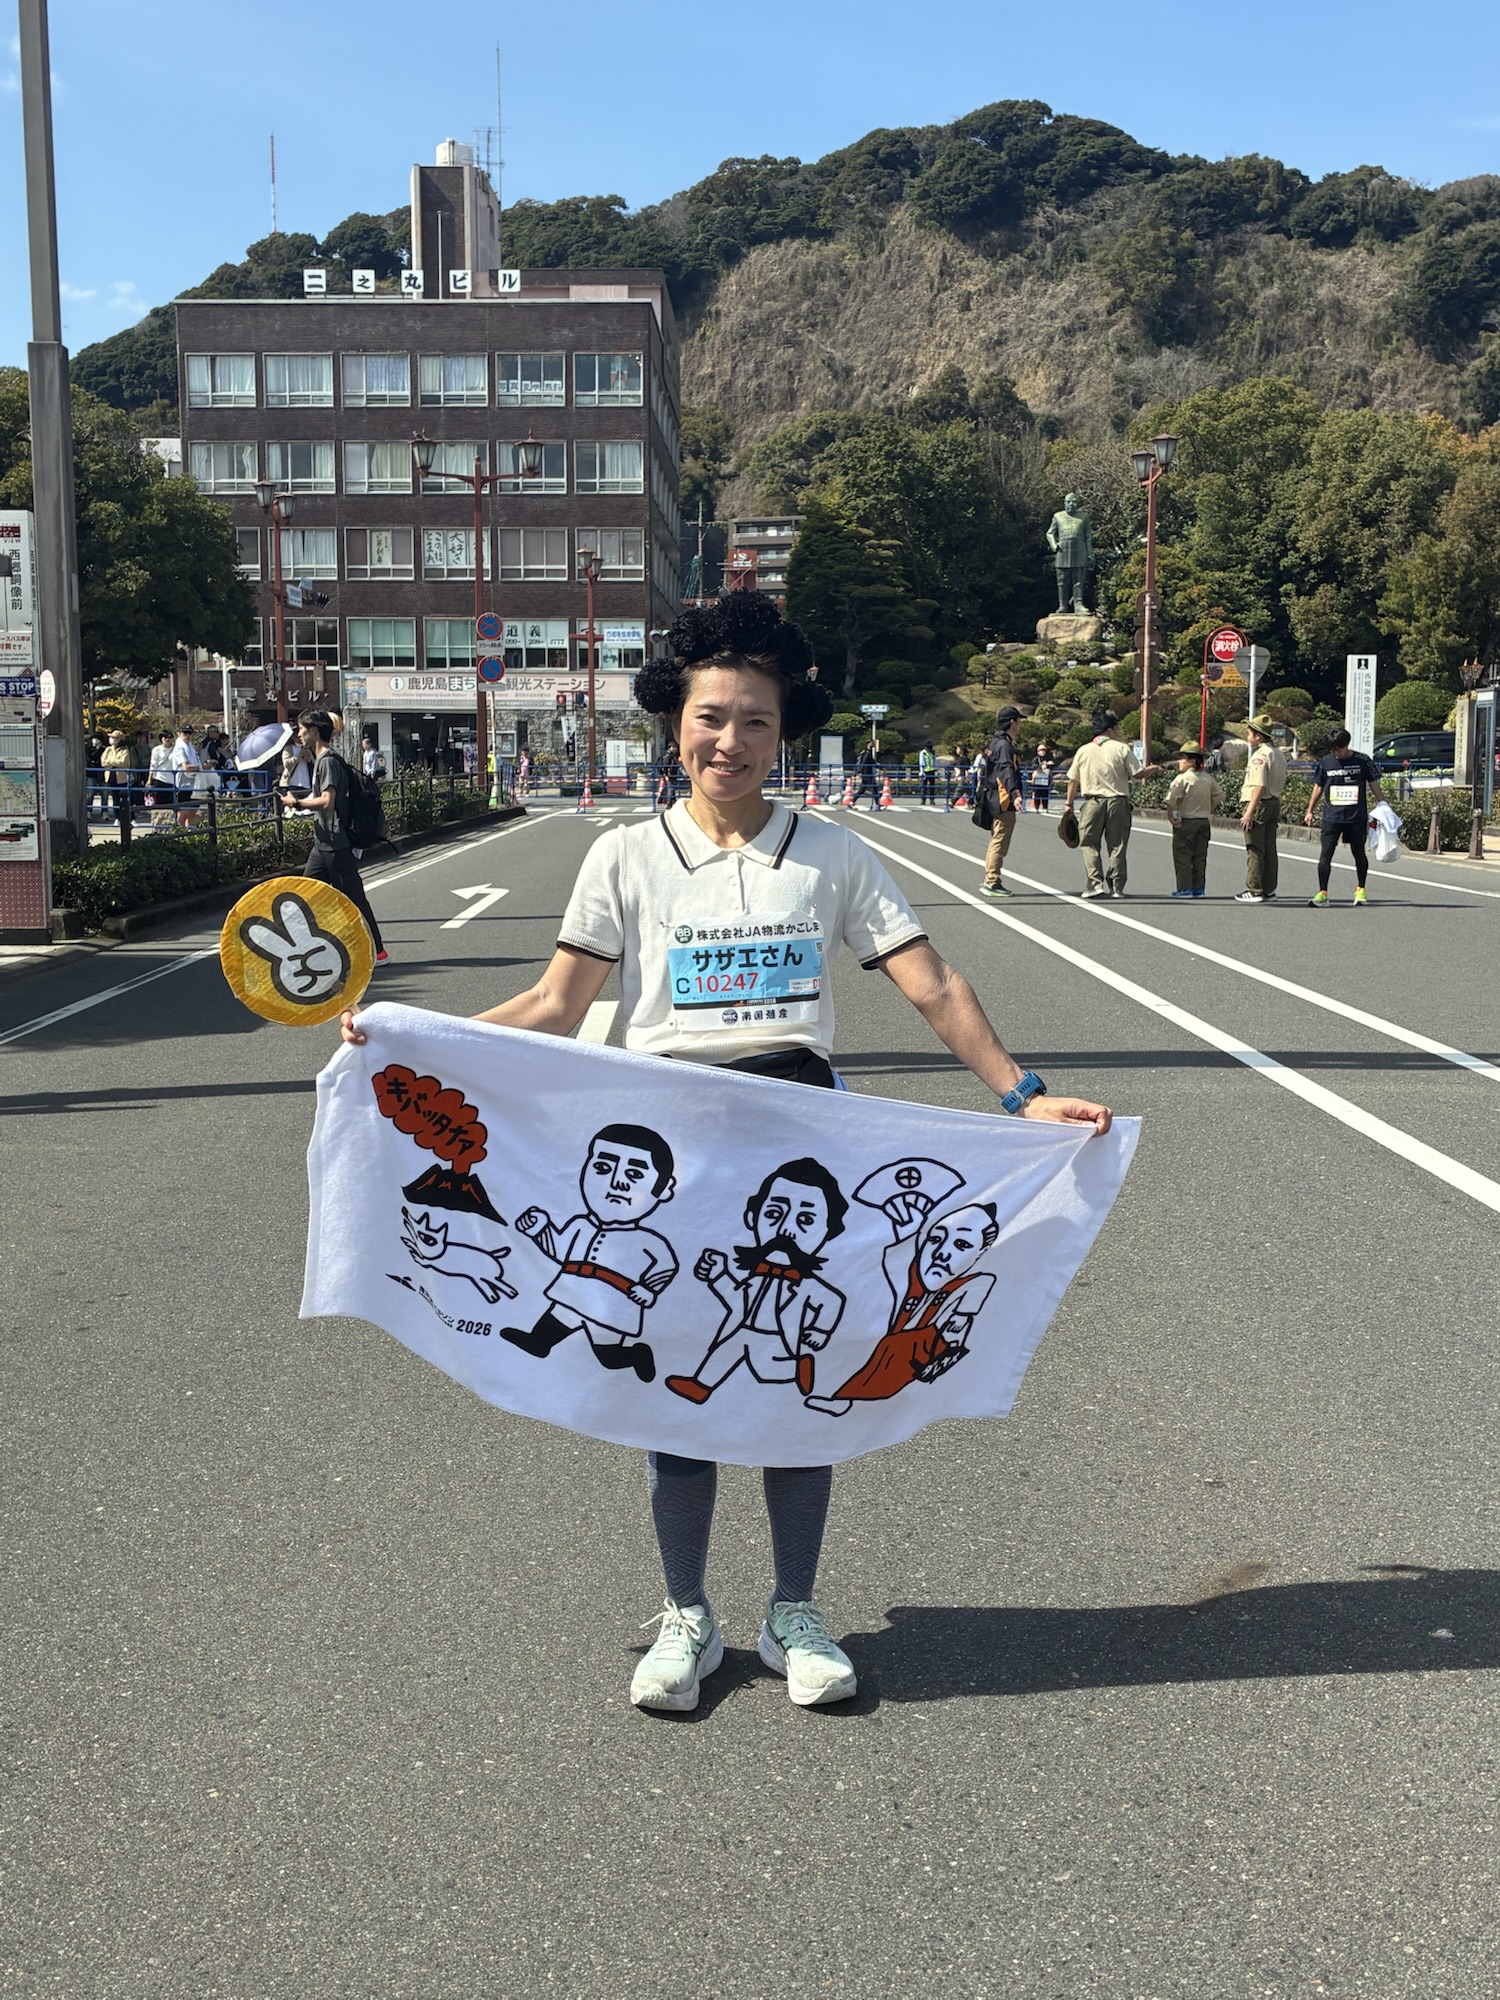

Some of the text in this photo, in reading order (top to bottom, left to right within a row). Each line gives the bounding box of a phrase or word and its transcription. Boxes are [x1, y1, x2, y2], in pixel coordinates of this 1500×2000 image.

[306, 270, 519, 292] 二之丸ビル
[1215, 640, 1240, 652] 消火栓
[8, 682, 35, 691] STOP
[697, 922, 820, 941] 株式会社JA物流かごしま
[692, 944, 803, 973] サザエさん
[676, 972, 759, 994] C 10247
[456, 1319, 492, 1336] 2026
